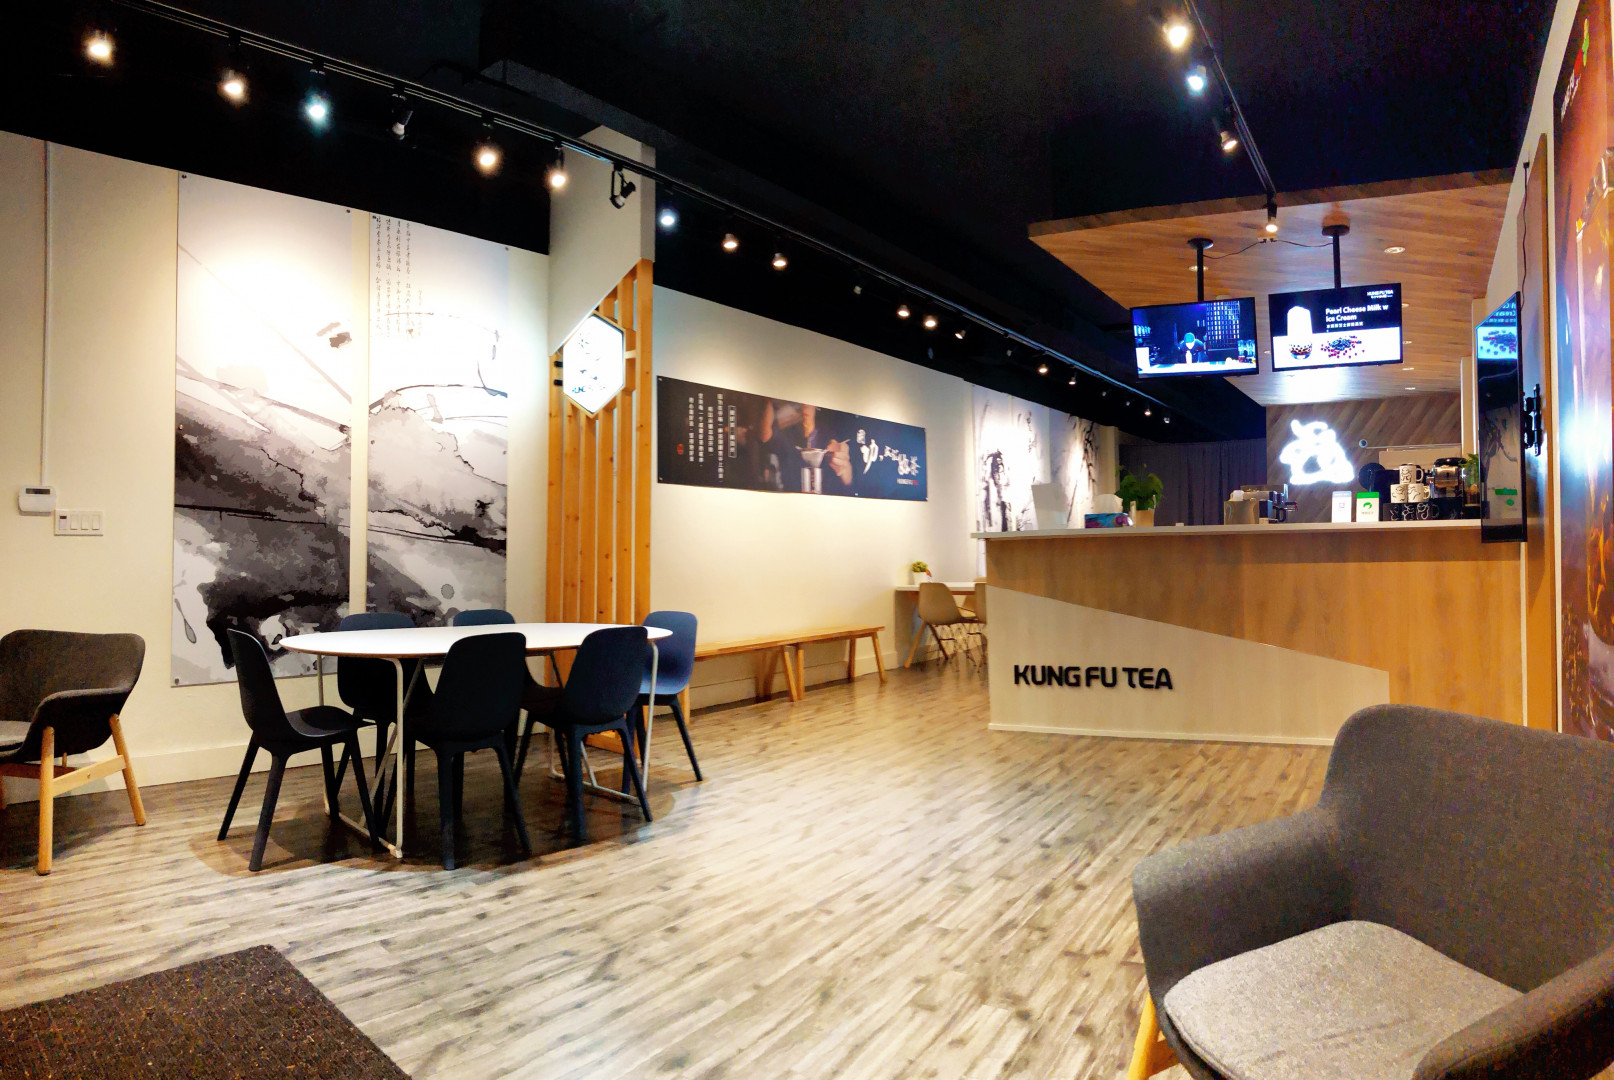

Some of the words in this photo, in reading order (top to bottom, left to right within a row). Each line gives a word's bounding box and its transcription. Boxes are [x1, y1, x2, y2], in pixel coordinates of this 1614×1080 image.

[1367, 304, 1382, 312] Milk
[1014, 665, 1081, 687] KUNG
[1085, 667, 1117, 688] FU
[1122, 667, 1173, 689] TEA
